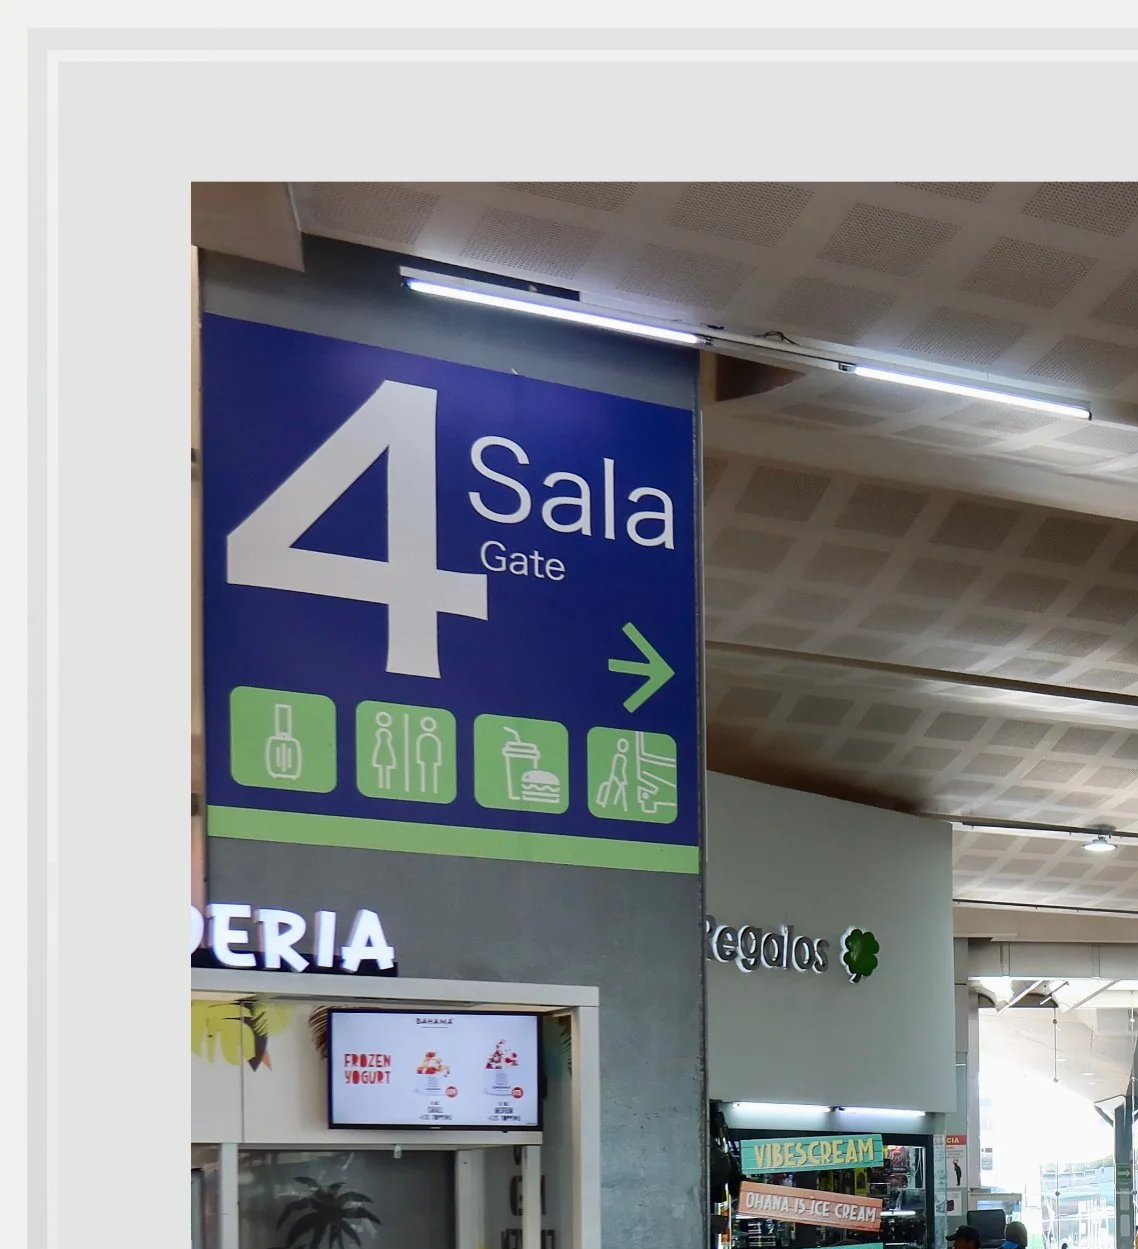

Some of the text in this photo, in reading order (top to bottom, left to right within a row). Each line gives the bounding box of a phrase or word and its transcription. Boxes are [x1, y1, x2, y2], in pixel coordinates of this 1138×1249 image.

[226, 379, 676, 679] 4 Sala
[479, 541, 567, 582] Gate
[344, 1053, 391, 1068] FROZEN
[344, 1070, 391, 1084] YOGURT
[754, 1138, 875, 1168] VIBESCREAM
[745, 1192, 877, 1222] OHANA IS ICE CREAM
